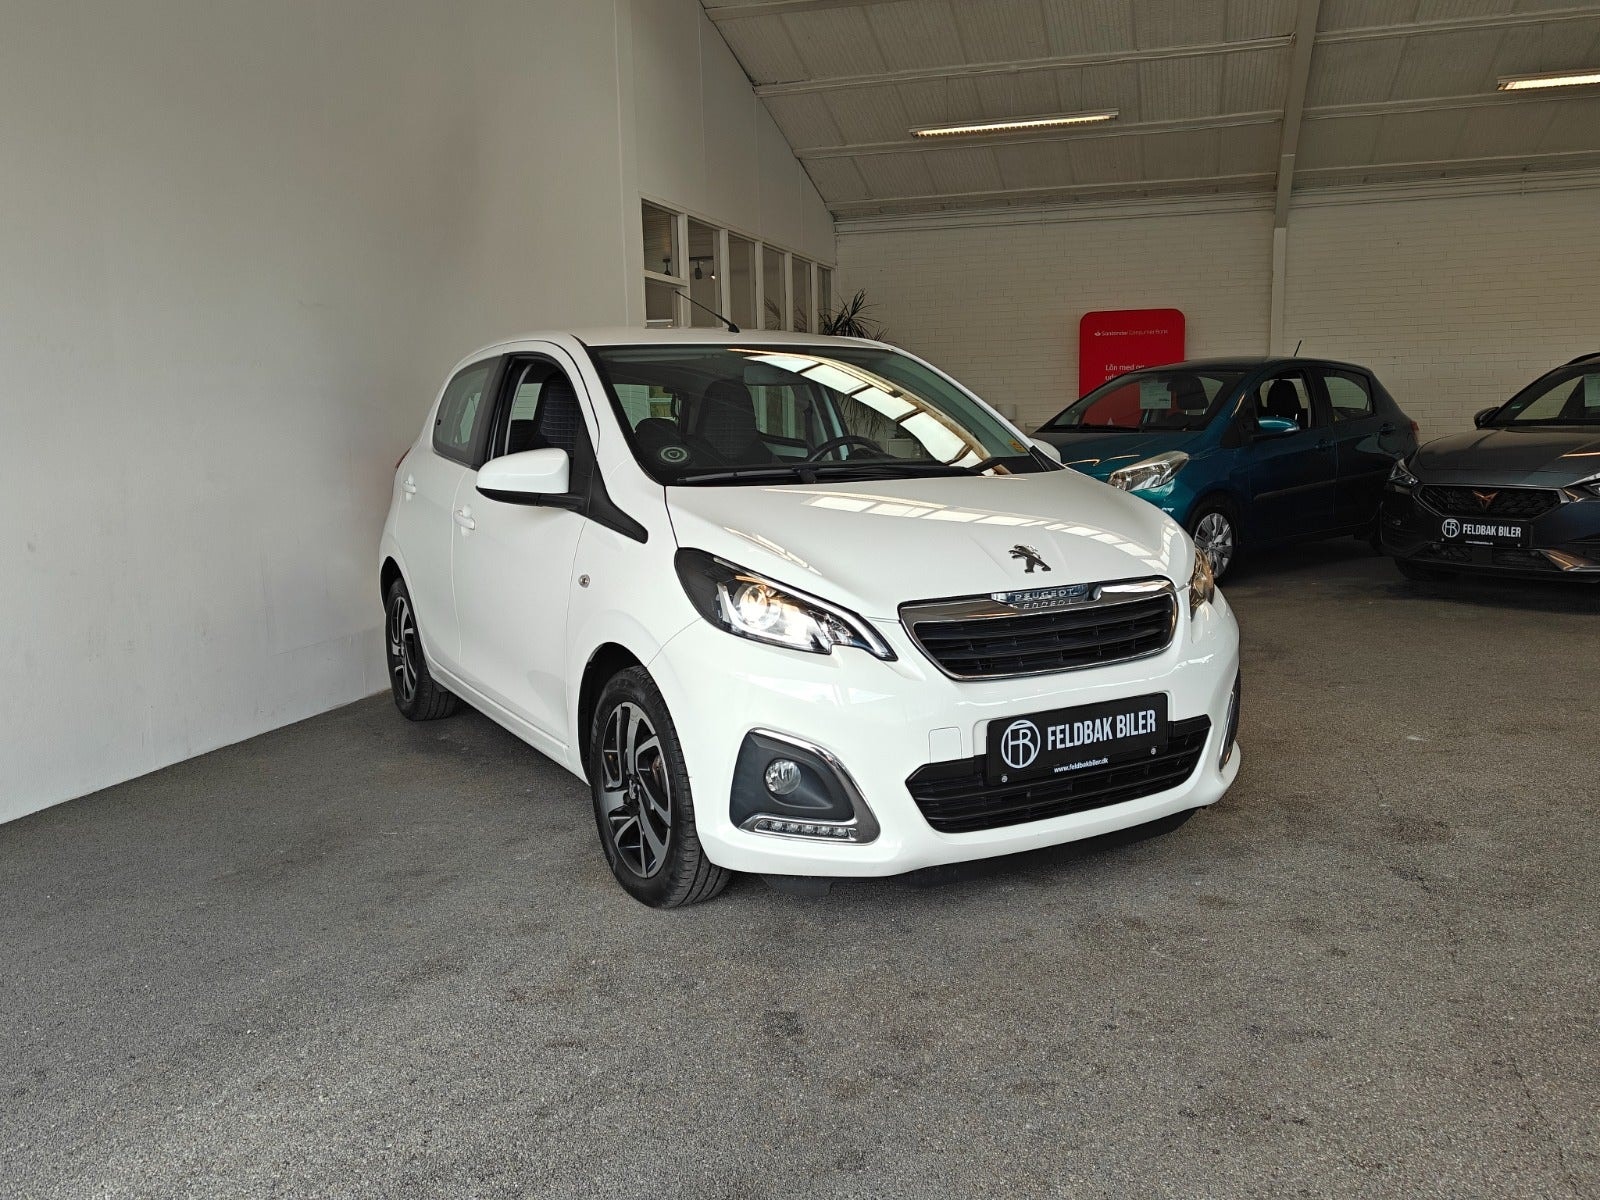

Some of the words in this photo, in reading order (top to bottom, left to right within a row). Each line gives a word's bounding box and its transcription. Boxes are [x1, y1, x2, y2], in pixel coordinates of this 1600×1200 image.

[1119, 363, 1135, 371] med
[1462, 523, 1497, 536] FELDBAK
[1498, 525, 1522, 538] BILER
[1015, 588, 1077, 601] PEUGEOT
[1047, 716, 1113, 751] FELDBAK
[1116, 709, 1156, 739] BILER
[1053, 757, 1109, 773] www.feldbakbiler.dk
